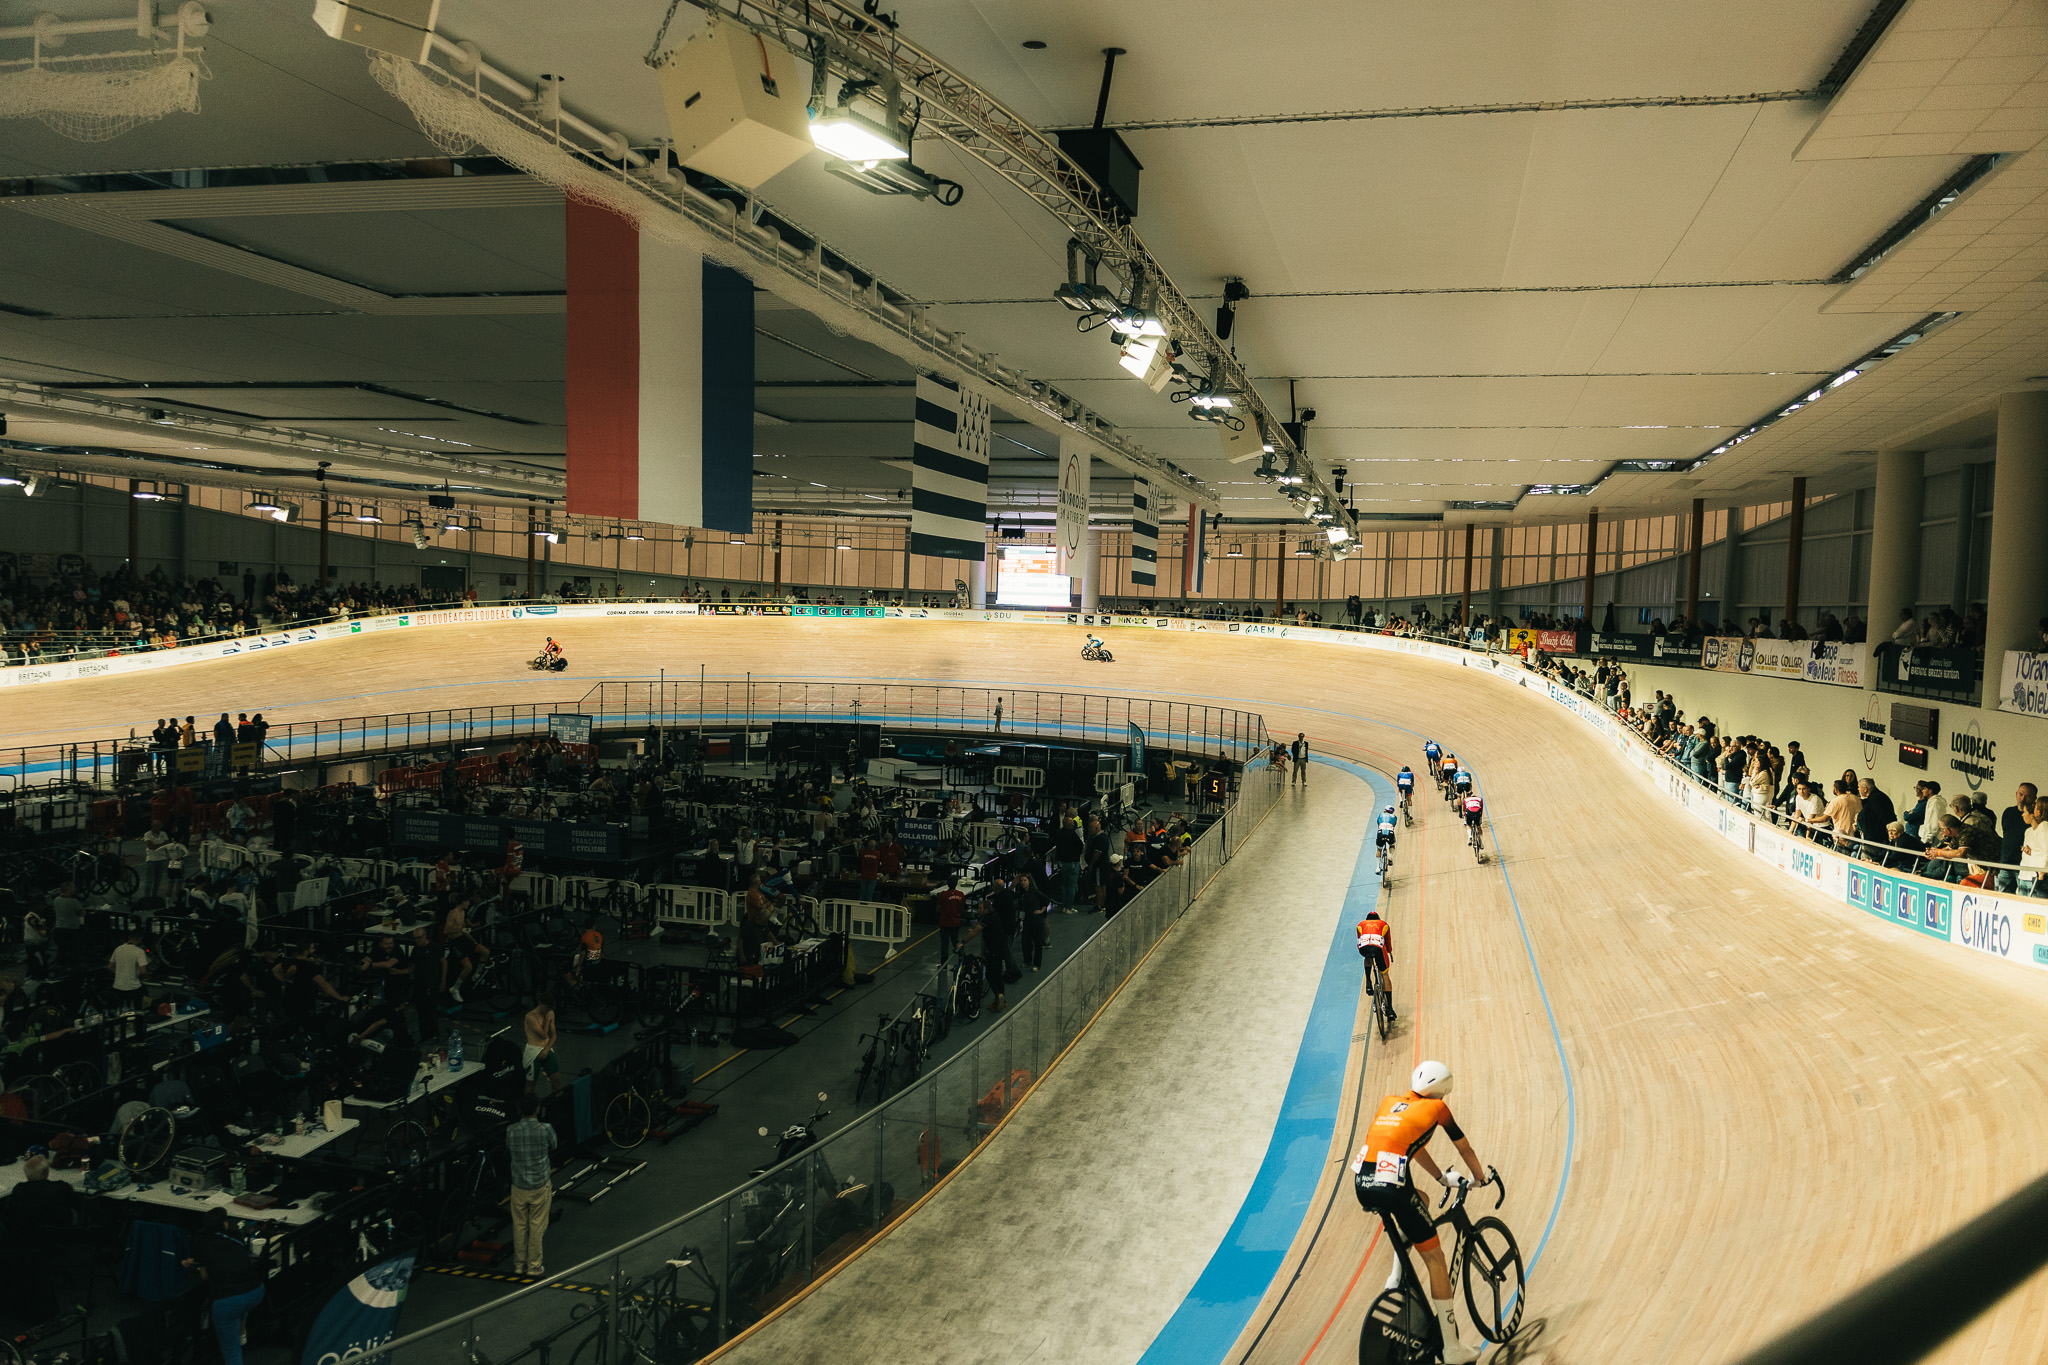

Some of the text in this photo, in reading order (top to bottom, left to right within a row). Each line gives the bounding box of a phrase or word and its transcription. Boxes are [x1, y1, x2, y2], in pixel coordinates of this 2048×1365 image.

[1252, 626, 1274, 634] AEM
[1560, 634, 1573, 647] Cola
[1838, 666, 1858, 684] Fitness
[2016, 652, 2048, 681] l'Oran
[18, 671, 51, 681] BRETAGNE
[1951, 732, 1996, 762] LOUDEAC
[1951, 758, 1994, 781] communauté
[1212, 780, 1219, 793] 5
[513, 826, 544, 834] ÉDÉRATION
[905, 822, 933, 830] ESPACE
[898, 832, 938, 840] COLLATION
[1792, 848, 1821, 880] SUPER U
[1852, 876, 1866, 898] CIC
[1875, 884, 1890, 908] CIC
[1900, 892, 1916, 916] CIC
[1928, 900, 1946, 926] CIC
[475, 1106, 505, 1117] CORIMA
[1378, 1160, 1397, 1174] 19
[1450, 1229, 1467, 1293] OOK
